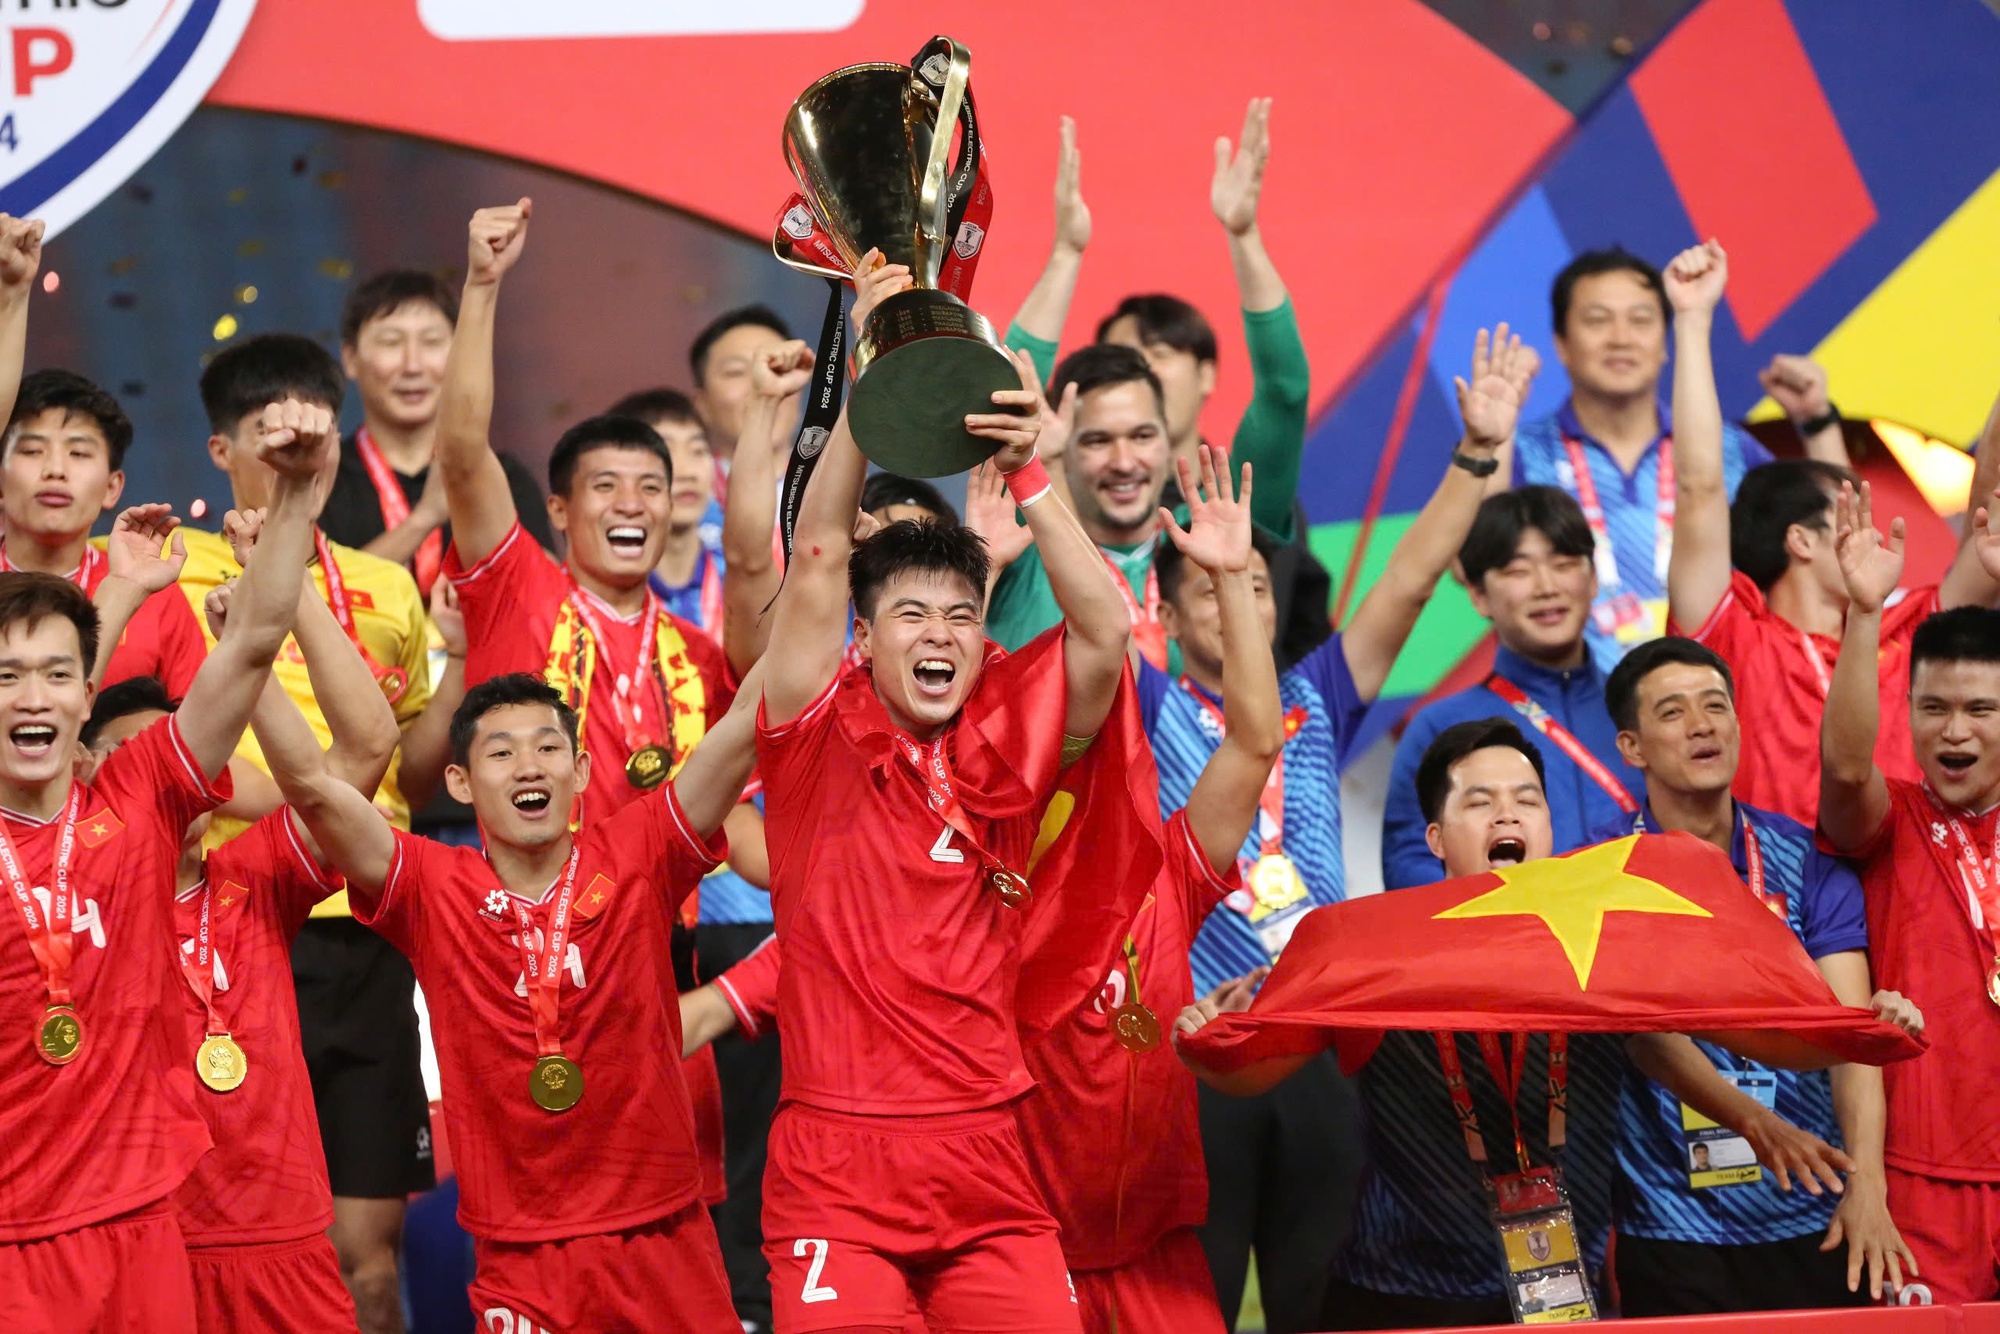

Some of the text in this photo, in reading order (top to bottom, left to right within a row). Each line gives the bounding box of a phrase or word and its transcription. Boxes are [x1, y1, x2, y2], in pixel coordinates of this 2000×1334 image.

[956, 173, 968, 191] CUP
[828, 321, 844, 363] ELECTRIC
[826, 364, 835, 385] CUP
[820, 386, 832, 409] 2024
[787, 464, 805, 510] MITSUBISHI
[933, 758, 946, 780] CUP
[58, 824, 75, 868] ELECTRIC
[1964, 846, 1978, 866] CUP
[57, 868, 67, 892] CUP
[14, 881, 29, 903] CUP
[23, 905, 39, 930] 2024
[56, 895, 66, 919] 2024
[555, 887, 571, 929] ELECTRIC
[200, 927, 208, 944] CUP
[522, 931, 533, 950] CUP
[551, 932, 562, 952] CUP
[200, 946, 208, 966] 2024
[527, 954, 538, 977] 2024
[547, 955, 558, 978] 2024
[793, 1238, 837, 1304] 2
